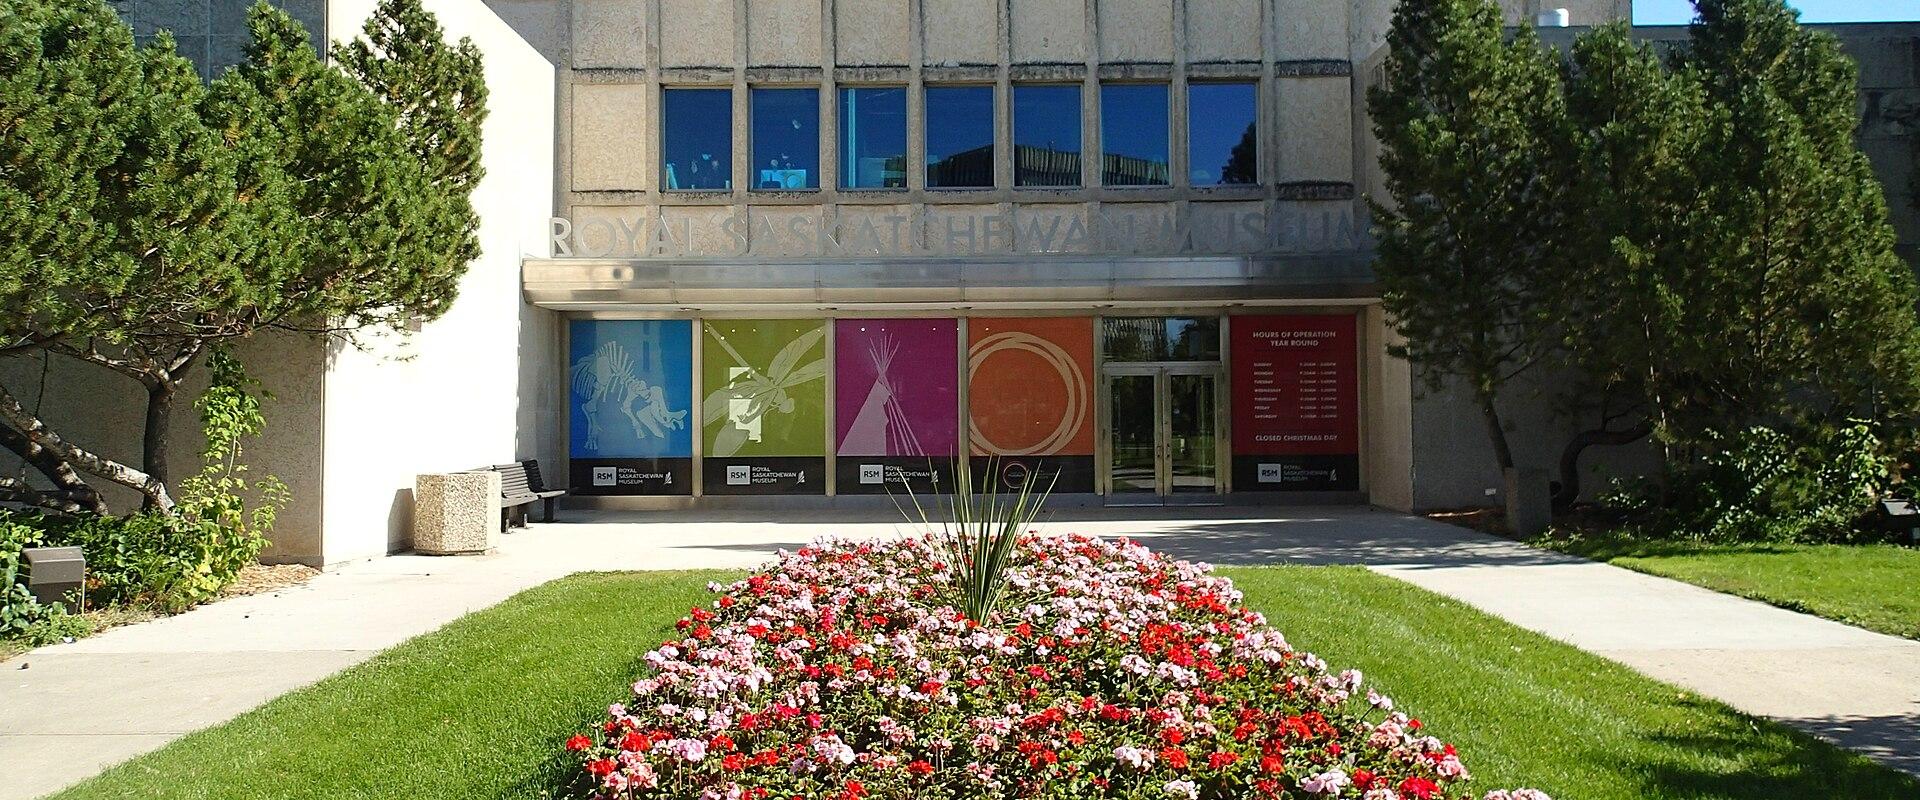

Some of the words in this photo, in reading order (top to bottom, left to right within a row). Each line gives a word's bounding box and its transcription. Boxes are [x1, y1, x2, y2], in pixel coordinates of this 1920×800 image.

[550, 216, 704, 258] ROYAL
[720, 215, 1136, 256] SASKATCHEWAN
[596, 472, 613, 480] RSM
[730, 471, 747, 479] RSM
[863, 470, 880, 478] RSM
[1261, 469, 1278, 477] RSM
